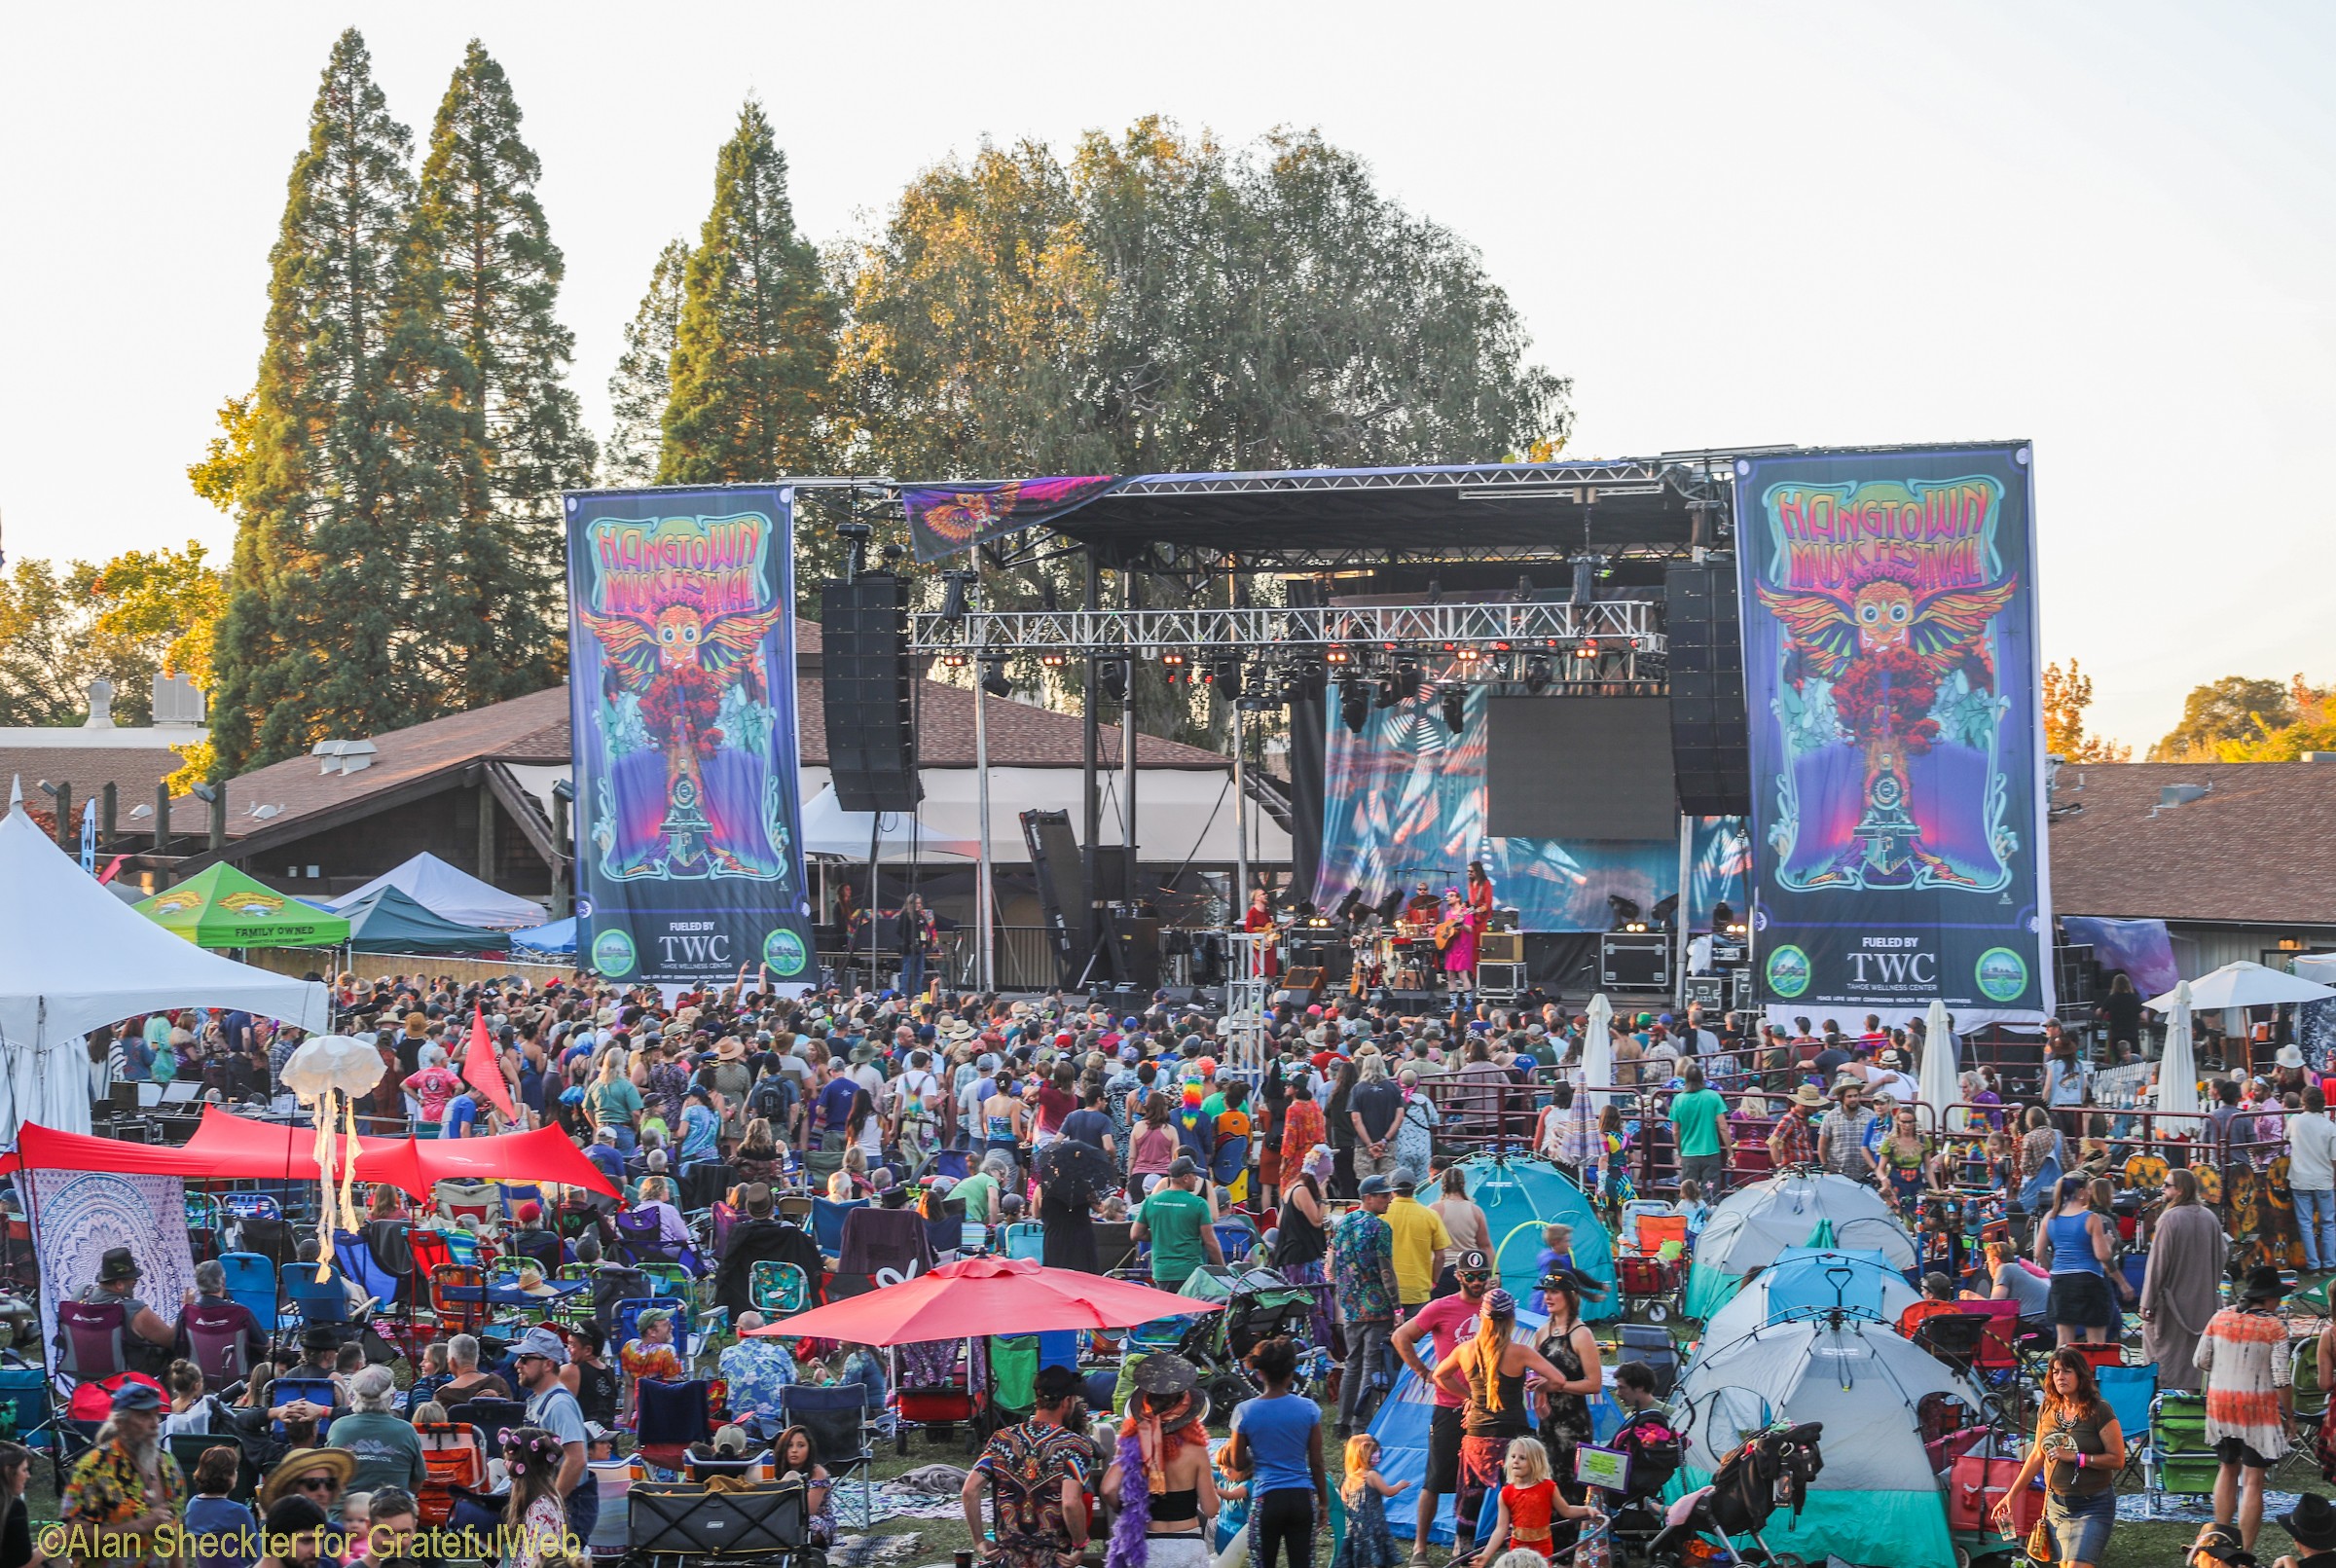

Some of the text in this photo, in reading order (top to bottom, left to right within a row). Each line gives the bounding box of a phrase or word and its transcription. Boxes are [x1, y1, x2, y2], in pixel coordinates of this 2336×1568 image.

[1778, 483, 1989, 543] HANGTOWN
[597, 520, 760, 571] HANGTOWN
[1789, 537, 1982, 589] MUSIC FESTIVAL
[235, 926, 315, 937] FAMILY OWNED
[670, 921, 715, 931] FUELED BY
[659, 934, 731, 963] TWC
[1862, 936, 1918, 948] FUELED BY
[1846, 953, 1936, 983] TWC
